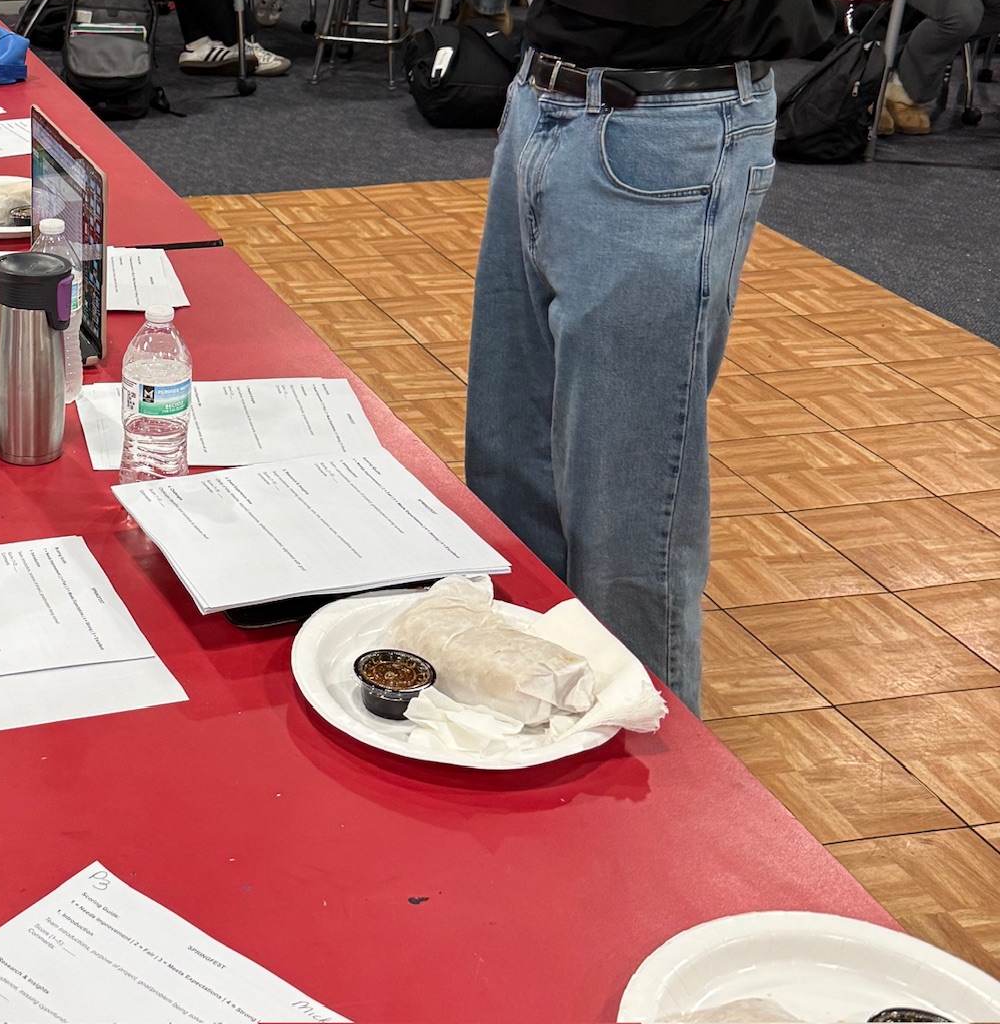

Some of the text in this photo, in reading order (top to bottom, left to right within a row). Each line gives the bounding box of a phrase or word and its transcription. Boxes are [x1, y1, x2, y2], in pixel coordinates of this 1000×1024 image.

[88, 870, 110, 890] P3
[81, 891, 102, 908] Scoring
[62, 913, 94, 936] Introduction
[79, 905, 96, 919] Needs
[96, 916, 131, 942] Improvement
[143, 947, 155, 958] Fair
[185, 974, 223, 1002] Expectations
[187, 945, 227, 970] SPRINGFEST
[27, 977, 50, 995] Insights
